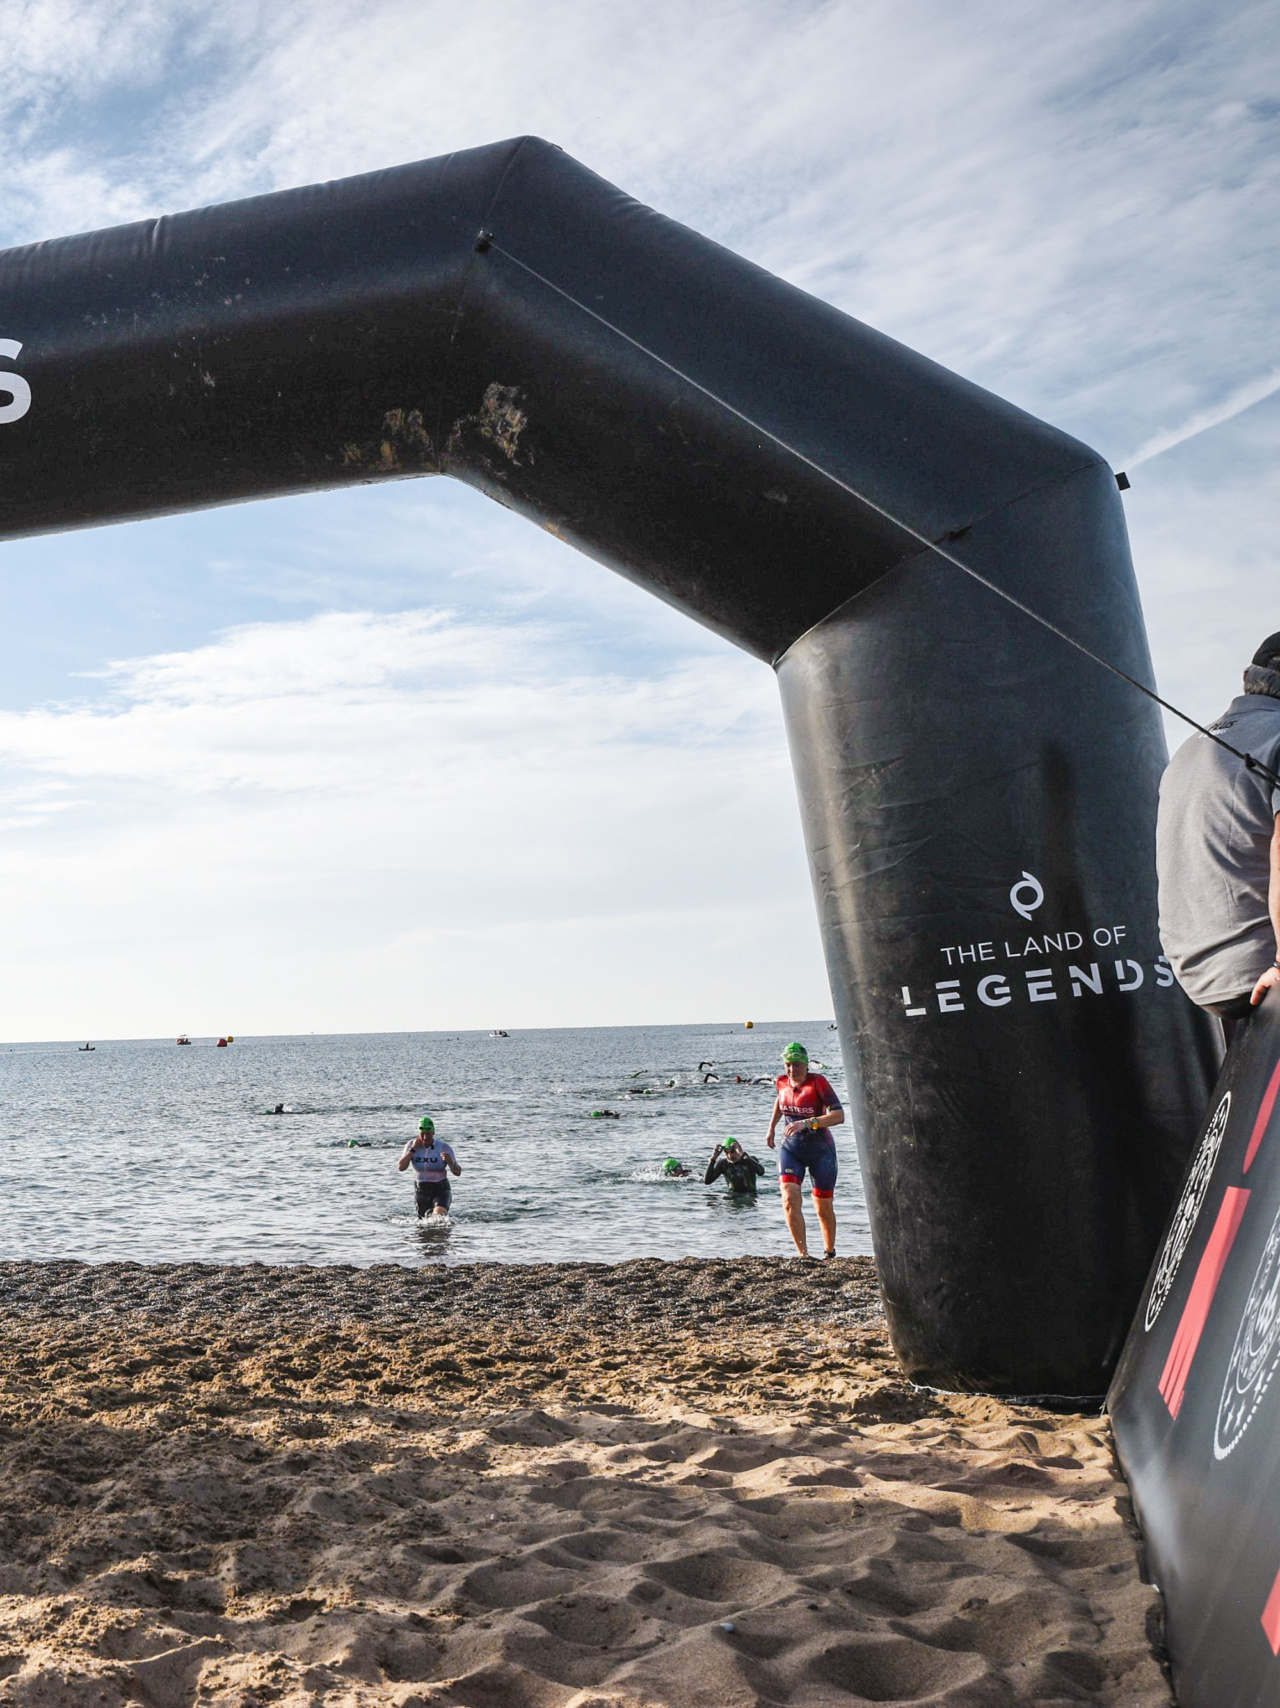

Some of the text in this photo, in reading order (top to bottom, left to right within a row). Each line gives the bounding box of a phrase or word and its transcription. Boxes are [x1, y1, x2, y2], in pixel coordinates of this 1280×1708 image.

[940, 925, 1127, 966] THE LAND OF
[901, 954, 1174, 1017] LEGENDS
[415, 1156, 439, 1164] 2XU
